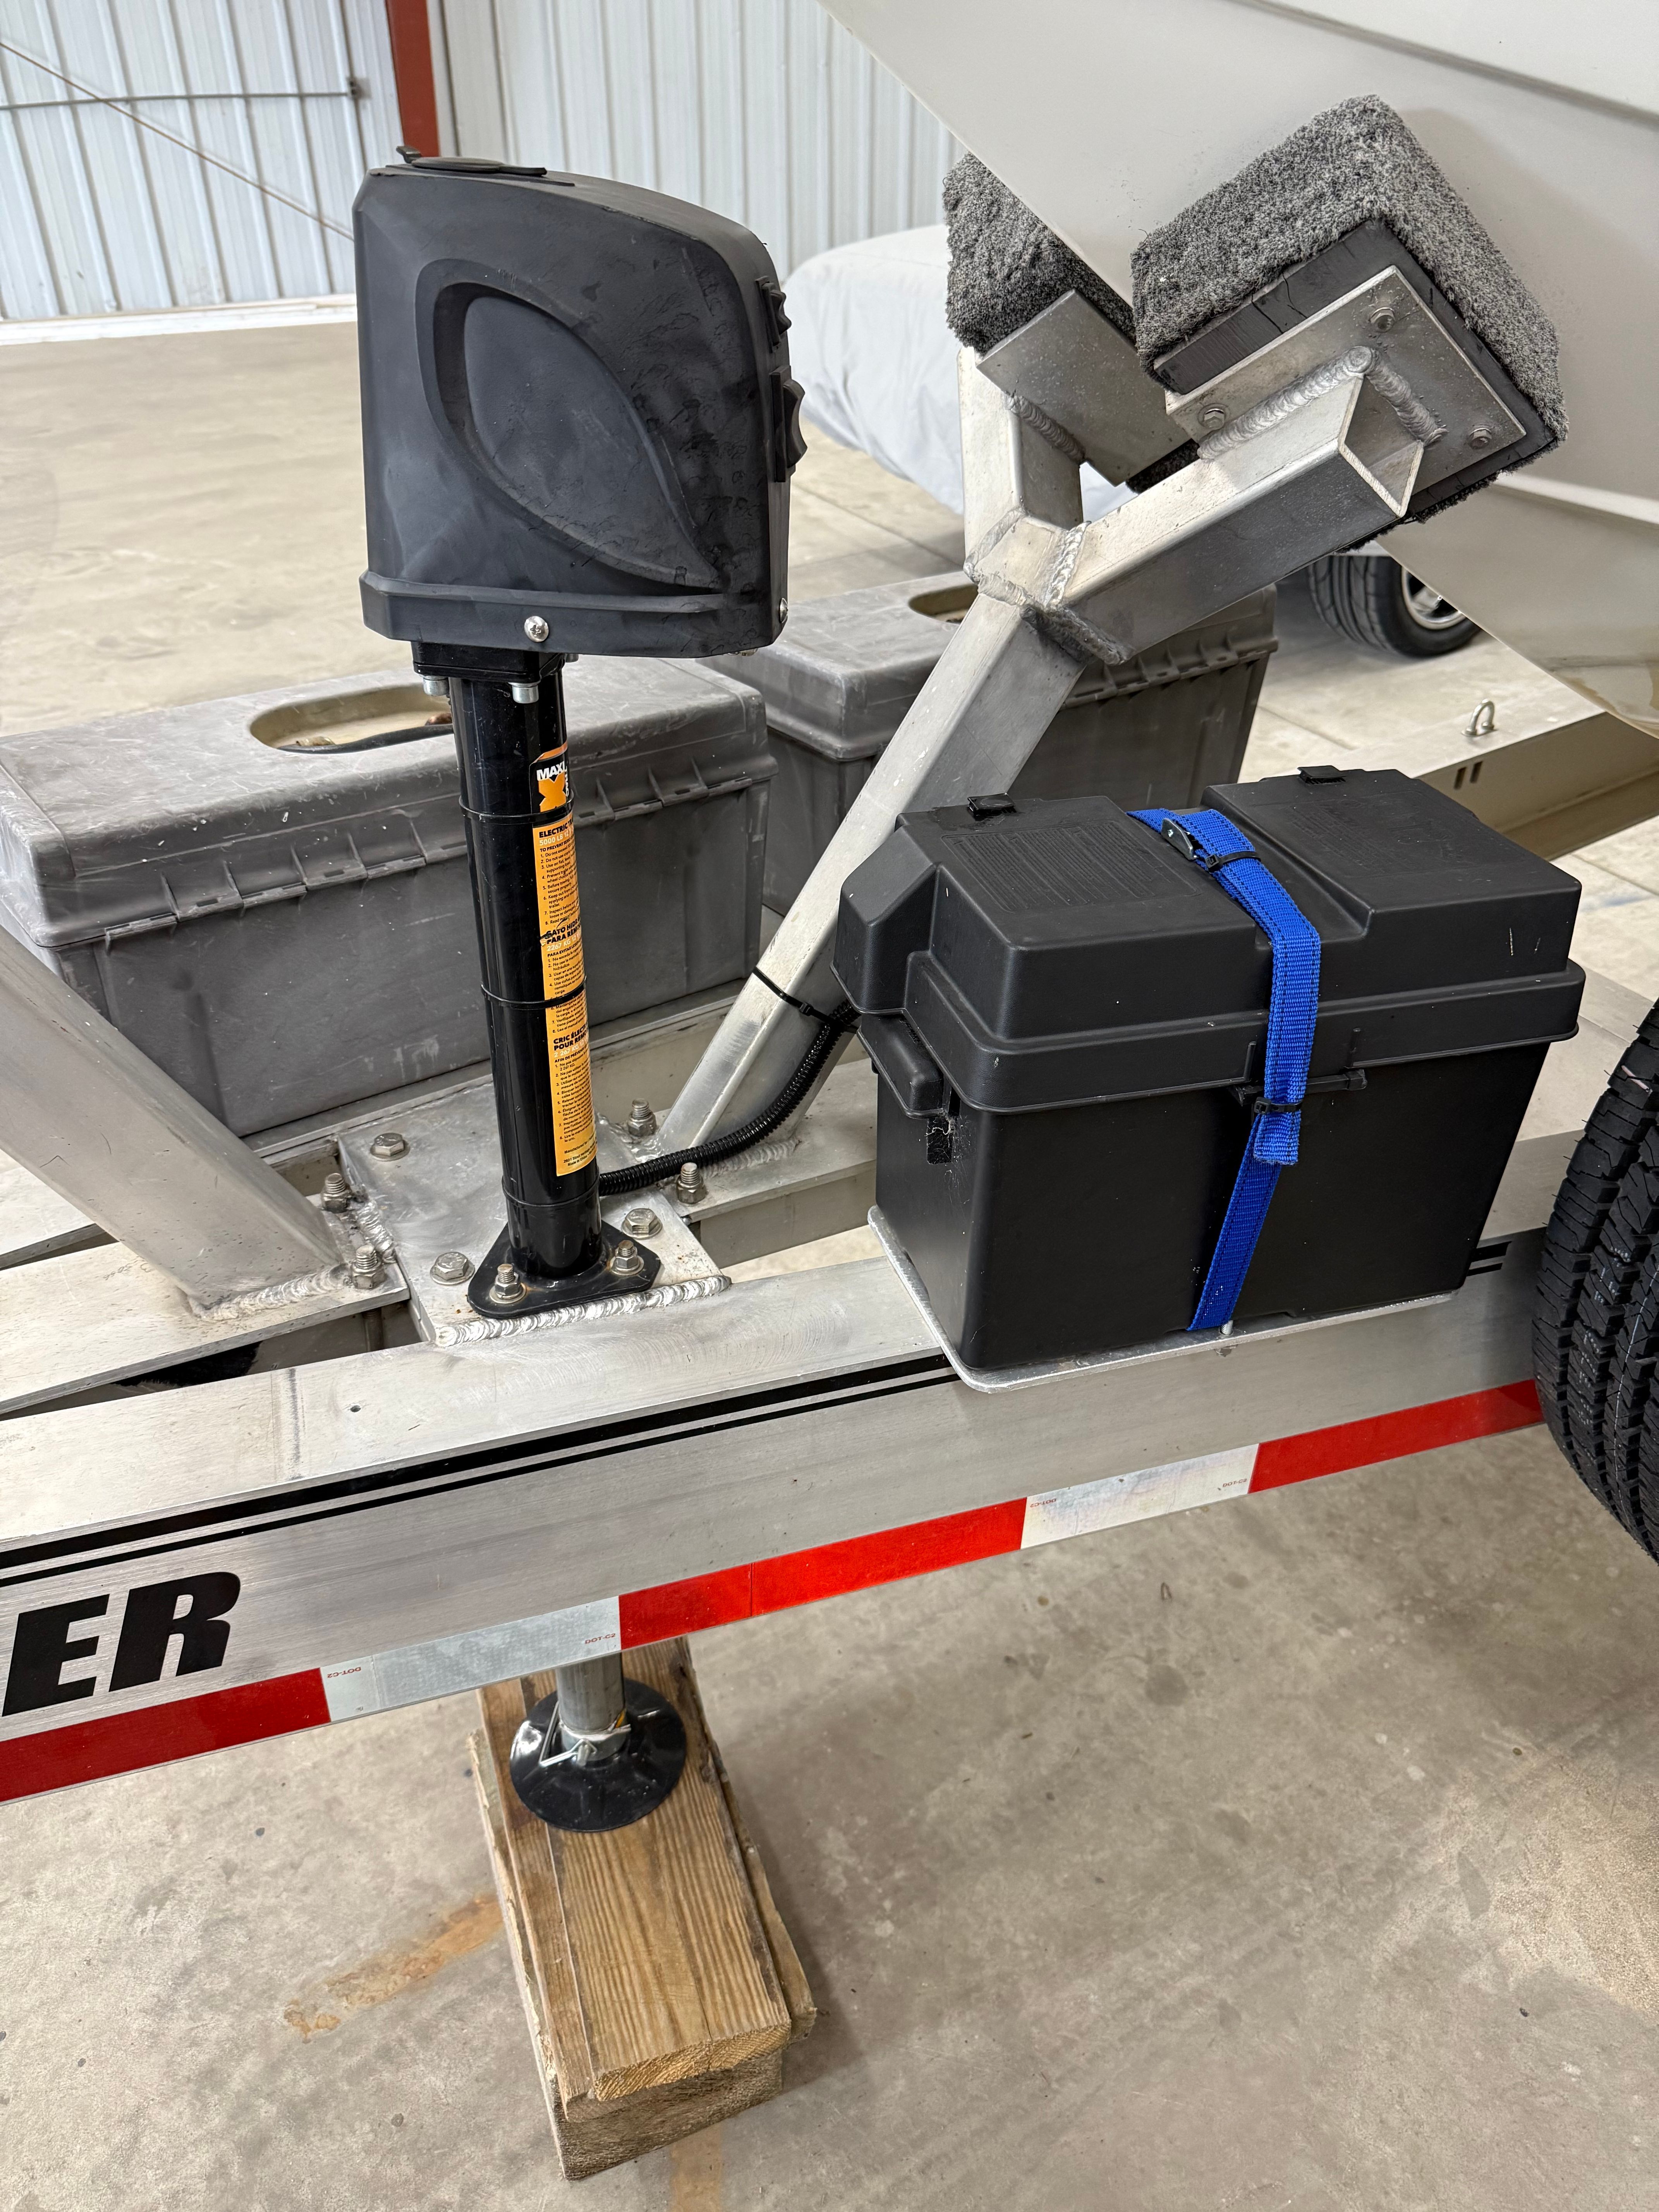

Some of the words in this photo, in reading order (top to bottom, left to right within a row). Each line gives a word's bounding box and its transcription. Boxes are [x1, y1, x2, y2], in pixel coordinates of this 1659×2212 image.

[537, 761, 565, 781] MAXI
[539, 823, 568, 838] ELECTRIC
[539, 837, 556, 846] 5000
[547, 843, 563, 851] PREVENT
[547, 864, 565, 874] supporting
[547, 943, 562, 951] 2267
[553, 1035, 570, 1044] CRIC
[554, 1040, 574, 1051] POUR
[560, 1048, 570, 1056] 267
[1223, 1479, 1247, 1487] DOT-C2
[1030, 1498, 1056, 1508] DOT-C2
[585, 1633, 615, 1644] DOT-C2
[2, 1571, 240, 1717] ER
[327, 1666, 361, 1678] DOT-C2
